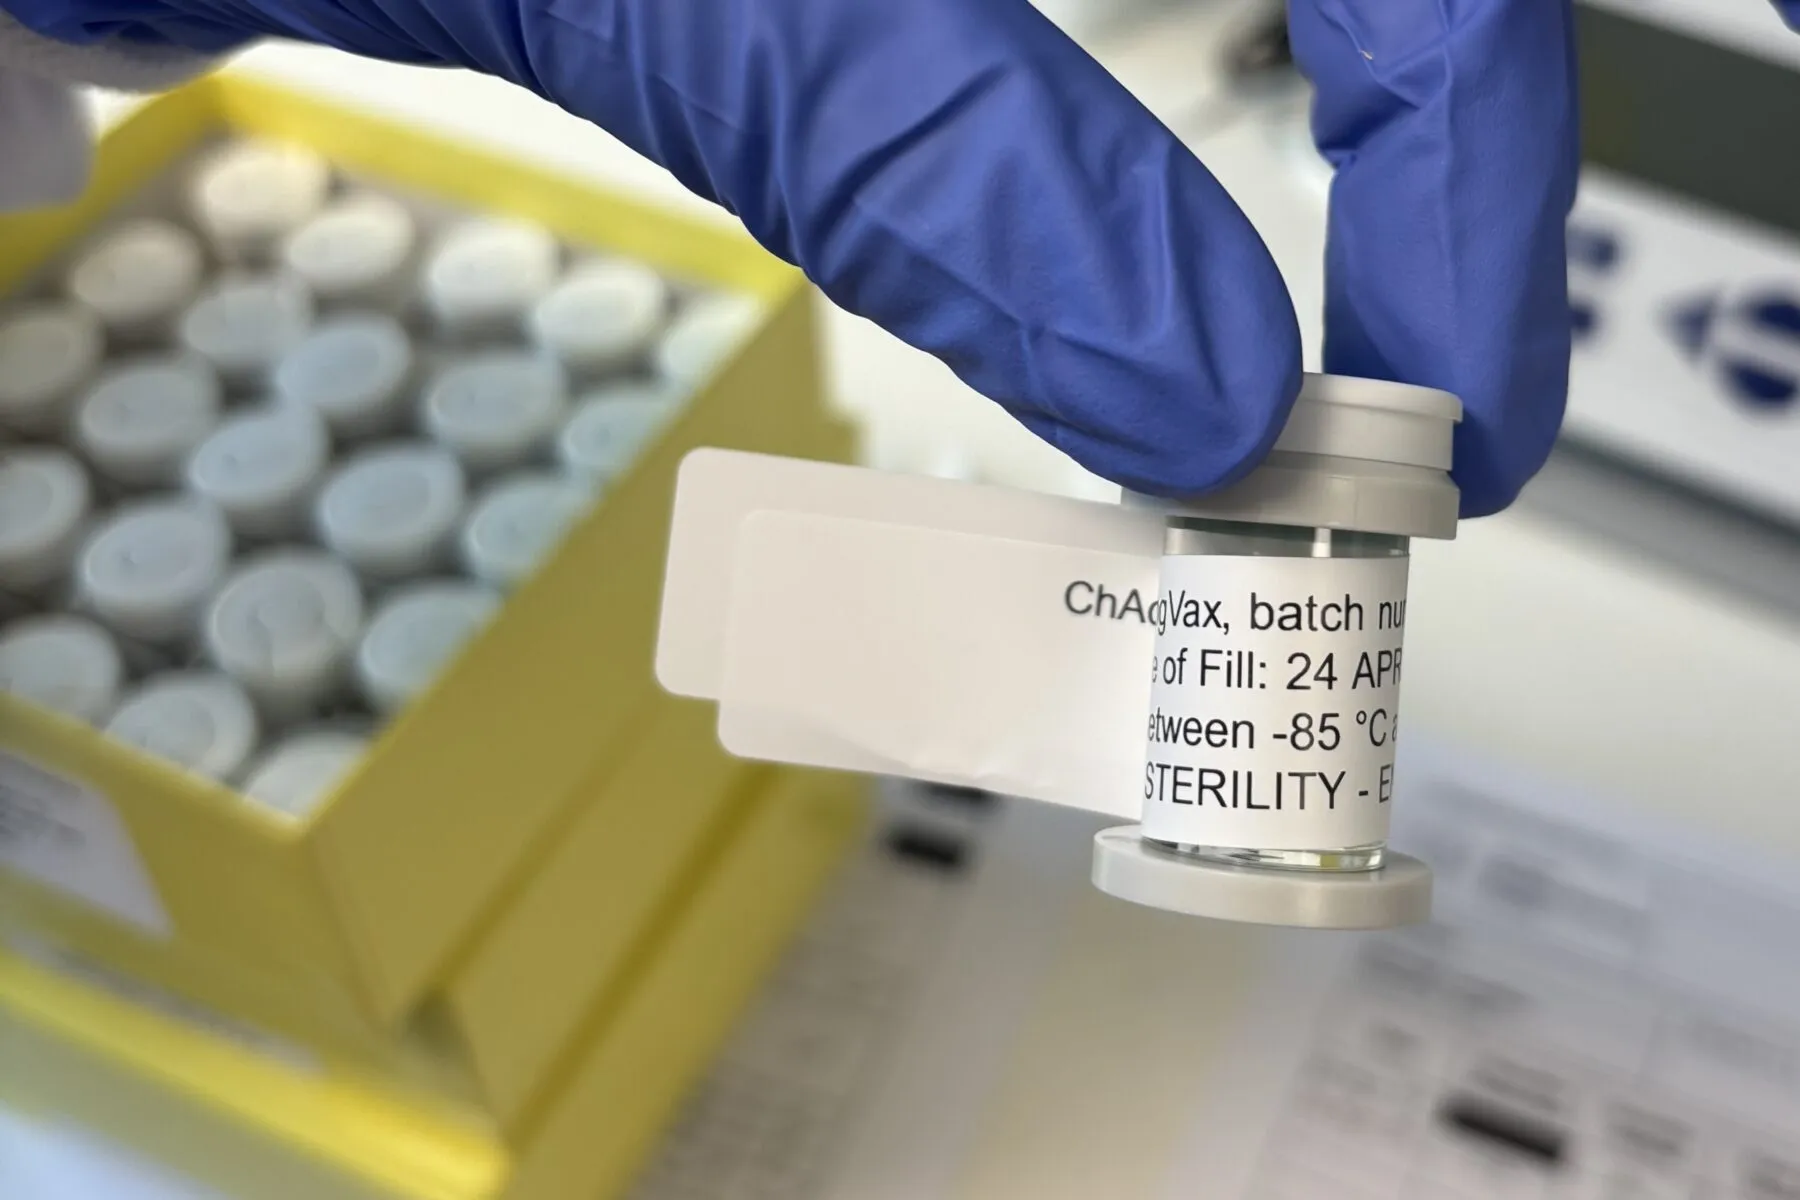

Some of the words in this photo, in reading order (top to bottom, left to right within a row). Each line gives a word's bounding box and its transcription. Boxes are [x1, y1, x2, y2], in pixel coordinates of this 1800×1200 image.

[1250, 592, 1363, 632] batch
[1379, 600, 1406, 629] nu
[1163, 648, 1188, 684] of
[1200, 649, 1266, 689] Fill:
[1286, 652, 1337, 690] 24
[1273, 713, 1341, 751] -85
[1356, 708, 1387, 747] °C
[1144, 761, 1346, 810] STERILITY
